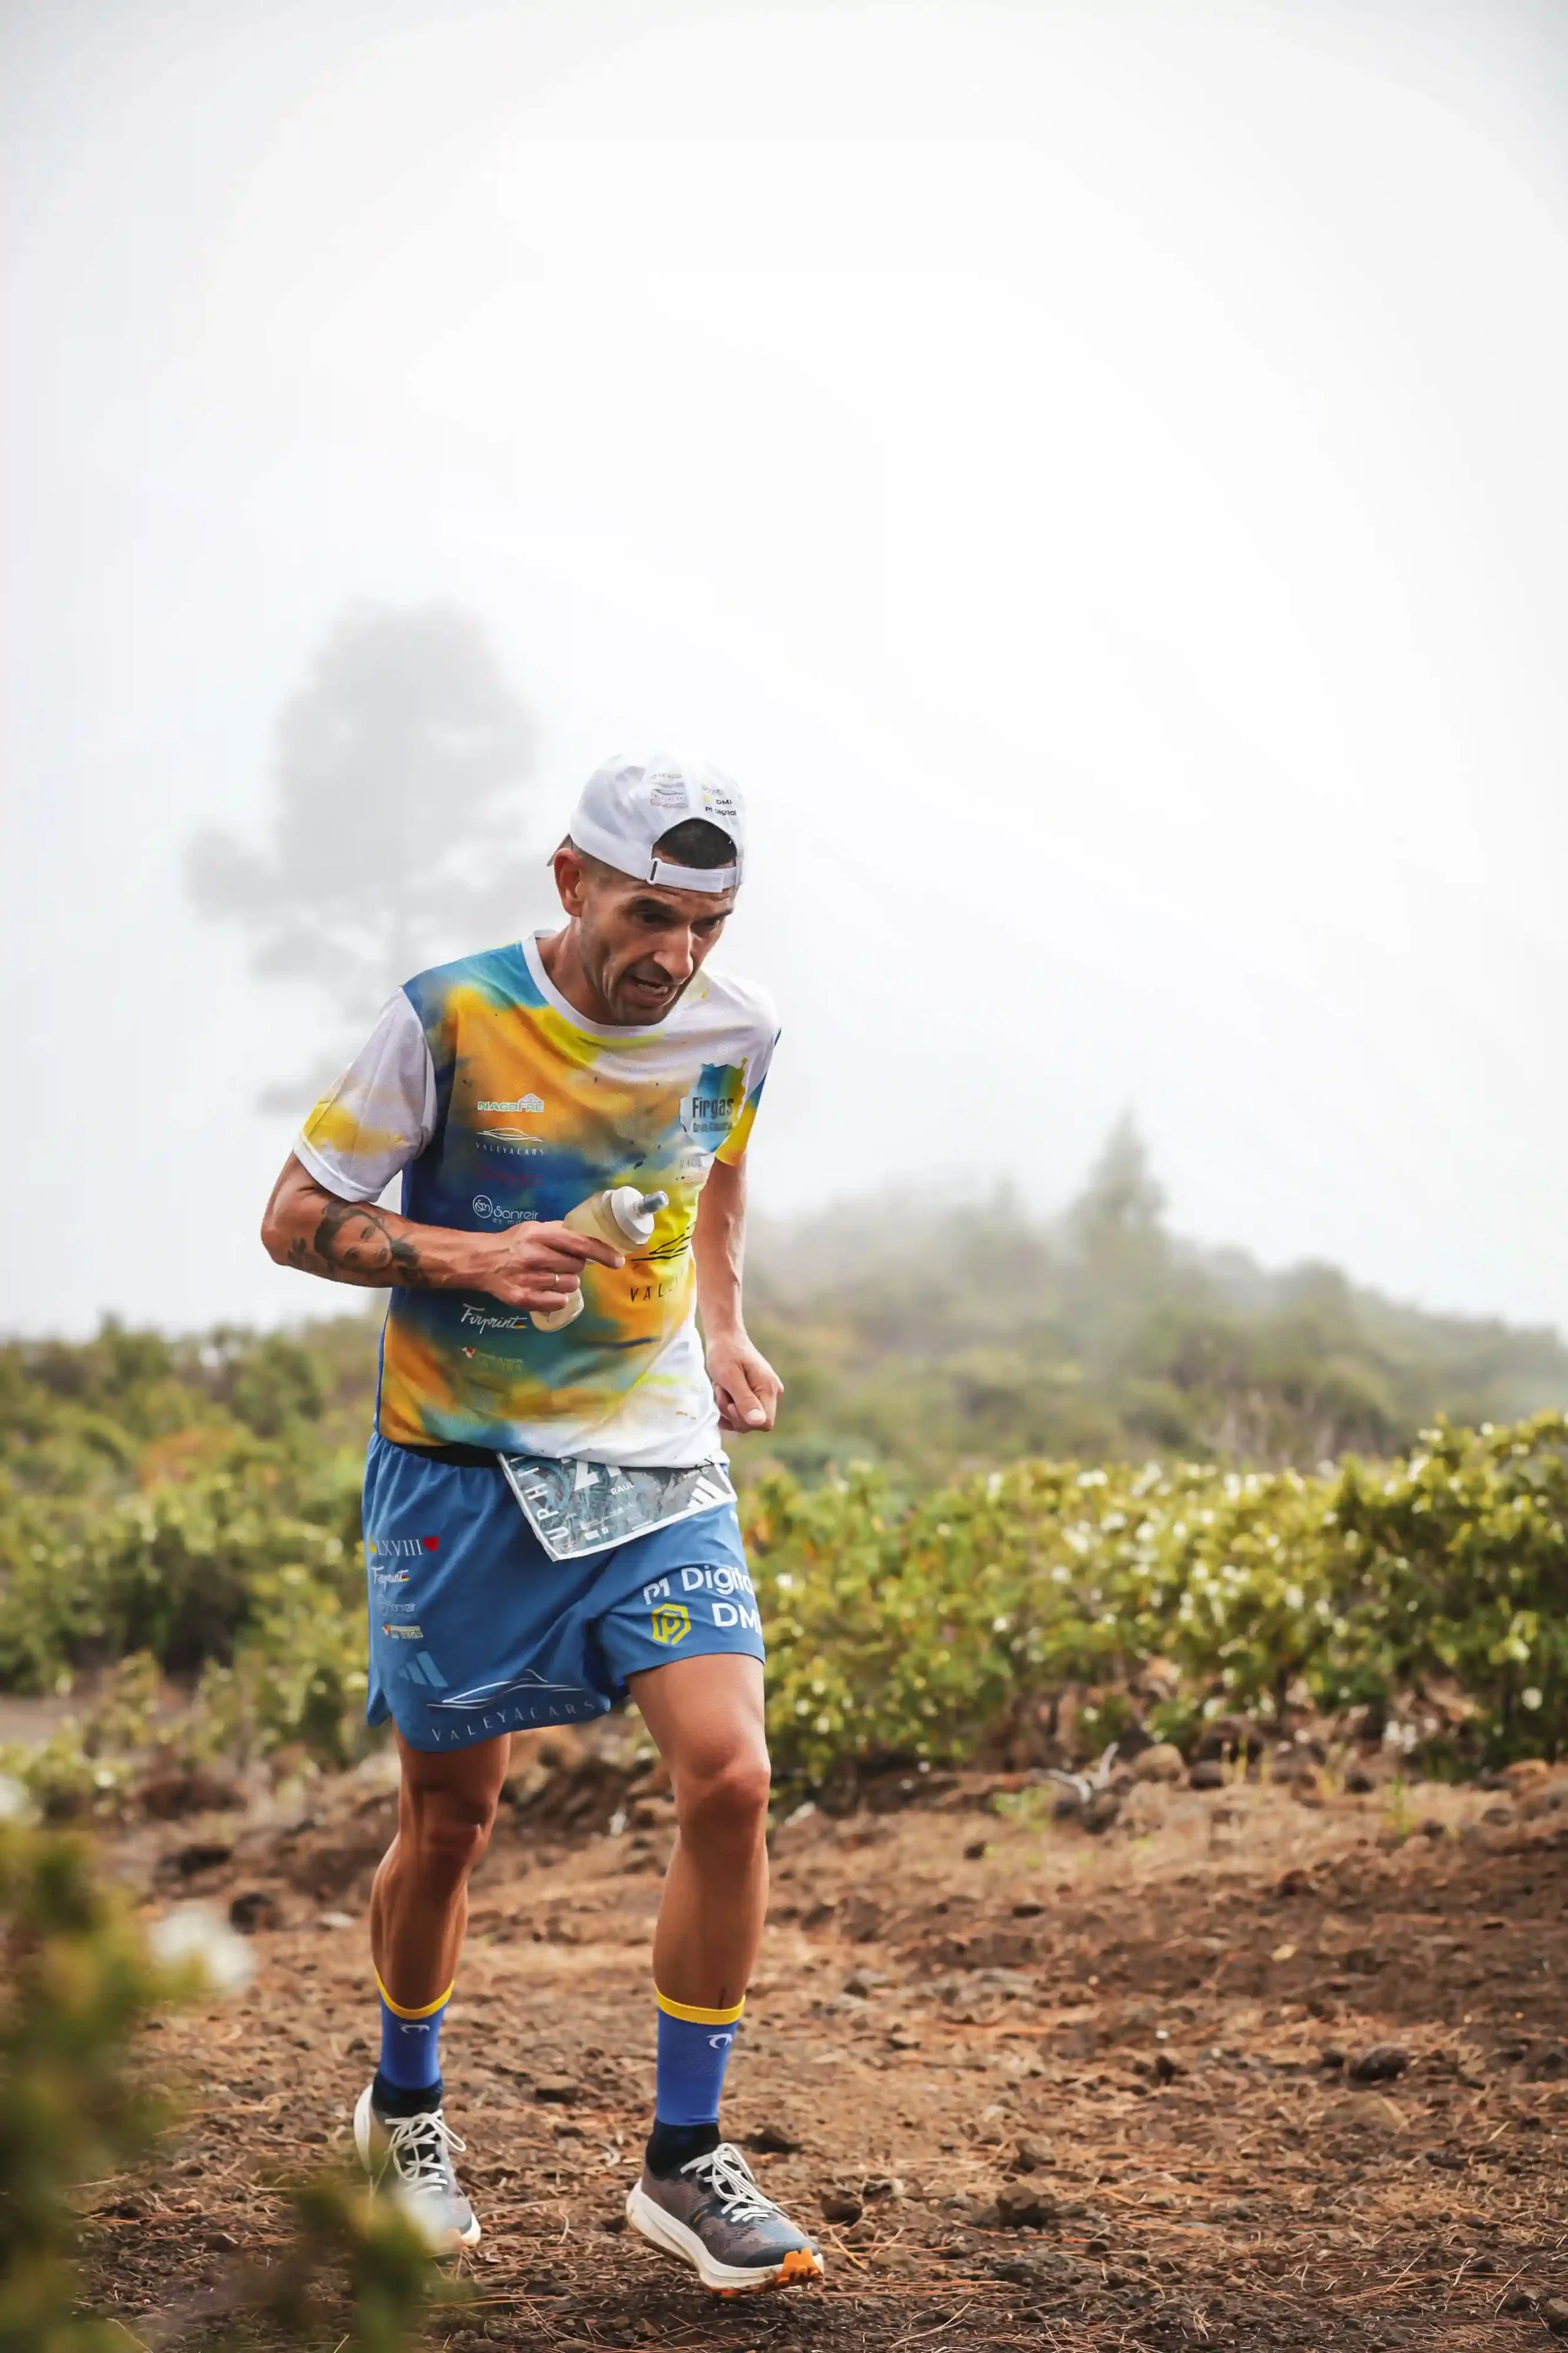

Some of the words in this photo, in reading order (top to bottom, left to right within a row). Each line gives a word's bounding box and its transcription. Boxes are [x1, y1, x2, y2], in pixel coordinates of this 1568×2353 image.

[692, 1097, 734, 1120] Firgas
[460, 1303, 527, 1334] Firprint
[681, 1565, 755, 1597] Digita
[431, 1700, 595, 1741] VALEYACARS
